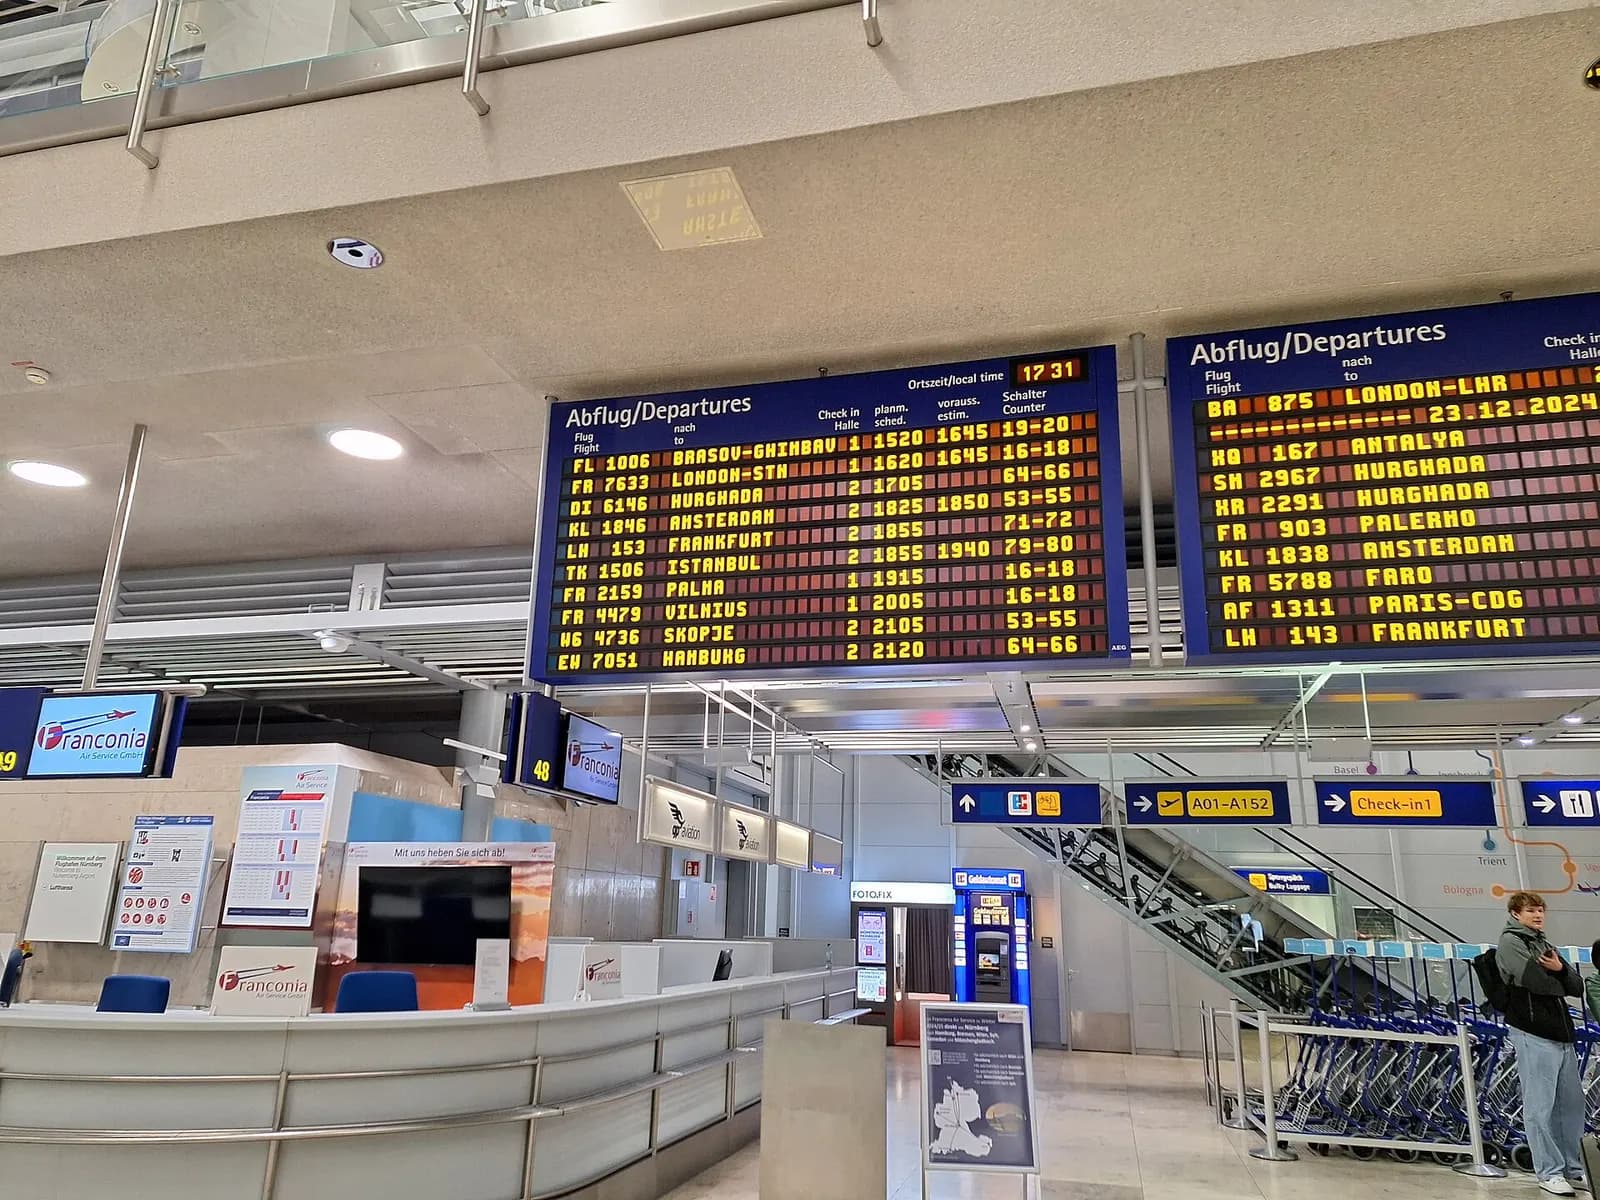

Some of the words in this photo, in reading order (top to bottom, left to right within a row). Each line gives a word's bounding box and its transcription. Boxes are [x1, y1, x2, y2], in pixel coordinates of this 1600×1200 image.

[1190, 323, 1448, 365] Abflug/Departures
[1543, 334, 1587, 348] Check
[1342, 355, 1373, 368] nach
[1569, 347, 1600, 360] Hall
[908, 374, 977, 390] Ortszeit/local
[980, 371, 1005, 383] time
[1204, 370, 1232, 382] Flug
[1344, 371, 1359, 382] to
[1002, 389, 1048, 402] Schalter
[1206, 382, 1242, 396] Flight
[1207, 399, 1237, 418] BA
[1268, 392, 1314, 412] 875
[1345, 374, 1508, 405] LONDON-LHR
[566, 397, 752, 428] Abflug/Departures
[818, 409, 848, 420] Check
[850, 407, 860, 417] in
[874, 404, 909, 418] planm.
[938, 397, 981, 409] vorauss.
[1002, 403, 1047, 415] Counter
[1429, 392, 1598, 424] 23.12.2024
[834, 420, 860, 431] Halle
[874, 416, 907, 427] sched.
[937, 410, 970, 421] estim.
[574, 432, 594, 443] Flug
[673, 423, 696, 433] nach
[573, 458, 594, 474] FL
[606, 453, 650, 471] 1006
[673, 437, 836, 466] BRASOV-GHIMBAV
[849, 435, 860, 451] 1
[874, 429, 923, 449] 1520
[937, 423, 988, 443] 1645
[1002, 415, 1069, 438] 19-20
[573, 443, 601, 454] Flight
[674, 436, 684, 445] to
[1211, 448, 1241, 467] XQ
[1272, 441, 1318, 462] 167
[1351, 430, 1465, 455] ANTALYA
[572, 479, 594, 495] FR
[605, 474, 649, 492] 7633
[672, 463, 788, 488] LONDON-STN
[849, 458, 860, 474] 1
[873, 452, 923, 471] 1620
[937, 446, 988, 466] 1645
[1003, 439, 1070, 461] 16-18
[1213, 472, 1243, 491] SM
[1259, 466, 1320, 488] 2967
[1353, 454, 1486, 481] HURGHADA
[570, 500, 592, 516] DI
[603, 496, 648, 514] 6146
[671, 487, 763, 509] HURGHADA
[848, 480, 860, 496] 2
[873, 474, 923, 494] 1705
[1003, 463, 1071, 484] 64-66
[1215, 498, 1245, 517] XR
[1262, 492, 1324, 514] 2291
[1356, 481, 1490, 507] HURGHADA
[569, 523, 590, 537] KL
[602, 517, 646, 535] 1846
[669, 508, 775, 531] AMSTERDAM
[848, 503, 860, 519] 2
[873, 497, 923, 517] 1825
[937, 492, 989, 513] 1850
[1004, 486, 1072, 507] 53-55
[567, 544, 589, 559] LH
[612, 539, 645, 557] 153
[668, 531, 773, 553] FRANKFURT
[847, 525, 859, 542] 2
[874, 521, 923, 540] 1855
[1004, 510, 1073, 532] 71-72
[1217, 523, 1247, 542] FR
[1279, 518, 1326, 538] 903
[1359, 509, 1476, 533] PALERMO
[566, 565, 587, 581] TK
[600, 561, 644, 579] 1506
[667, 555, 761, 575] ISTANBUL
[847, 548, 859, 565] 2
[873, 544, 923, 563] 1855
[937, 540, 990, 560] 1940
[1005, 534, 1073, 555] 79-80
[1219, 549, 1249, 568] KL
[1266, 544, 1329, 565] 1838
[1363, 534, 1515, 560] AMSTERDAM
[563, 587, 586, 603] FR
[597, 583, 643, 601] 2159
[666, 579, 724, 598] PALMA
[847, 573, 859, 588] 1
[873, 568, 924, 587] 1915
[1005, 559, 1074, 580] 16-18
[1221, 575, 1252, 594] FR
[1268, 571, 1332, 592] 5788
[1365, 566, 1433, 587] FARO
[562, 609, 584, 625] FR
[596, 606, 641, 624] 4479
[665, 601, 747, 621] VILNIUS
[847, 596, 859, 612] 1
[872, 592, 924, 611] 2005
[1006, 584, 1076, 605] 16-18
[1223, 601, 1253, 620] AF
[1271, 597, 1335, 618] 1311
[1369, 589, 1523, 614] PARIS-CDG
[560, 631, 582, 648] W6
[594, 629, 640, 646] 4736
[664, 624, 734, 644] SKOPJE
[847, 619, 858, 636] 2
[872, 616, 924, 635] 2105
[1007, 609, 1077, 629] 53-55
[1225, 628, 1257, 647] LH
[1289, 625, 1338, 645] 143
[1372, 617, 1526, 642] FRANKFURT
[558, 654, 581, 671] EW
[592, 652, 638, 669] 7051
[846, 643, 858, 660] 2
[872, 641, 924, 659] 2120
[1007, 635, 1078, 655] 64-66
[38, 722, 146, 750] Franconia
[80, 752, 91, 760] Air
[92, 751, 119, 760] Service
[568, 740, 619, 780] Franconia
[533, 759, 550, 782] 48
[1334, 766, 1359, 774] Basel
[394, 848, 407, 857] Mit
[428, 848, 454, 857] heben
[456, 848, 469, 857] Sie
[471, 848, 489, 857] sich
[491, 848, 505, 857] ab!
[1478, 856, 1507, 866] Trient
[1443, 884, 1484, 897] Bologna
[219, 971, 308, 992] Franconia
